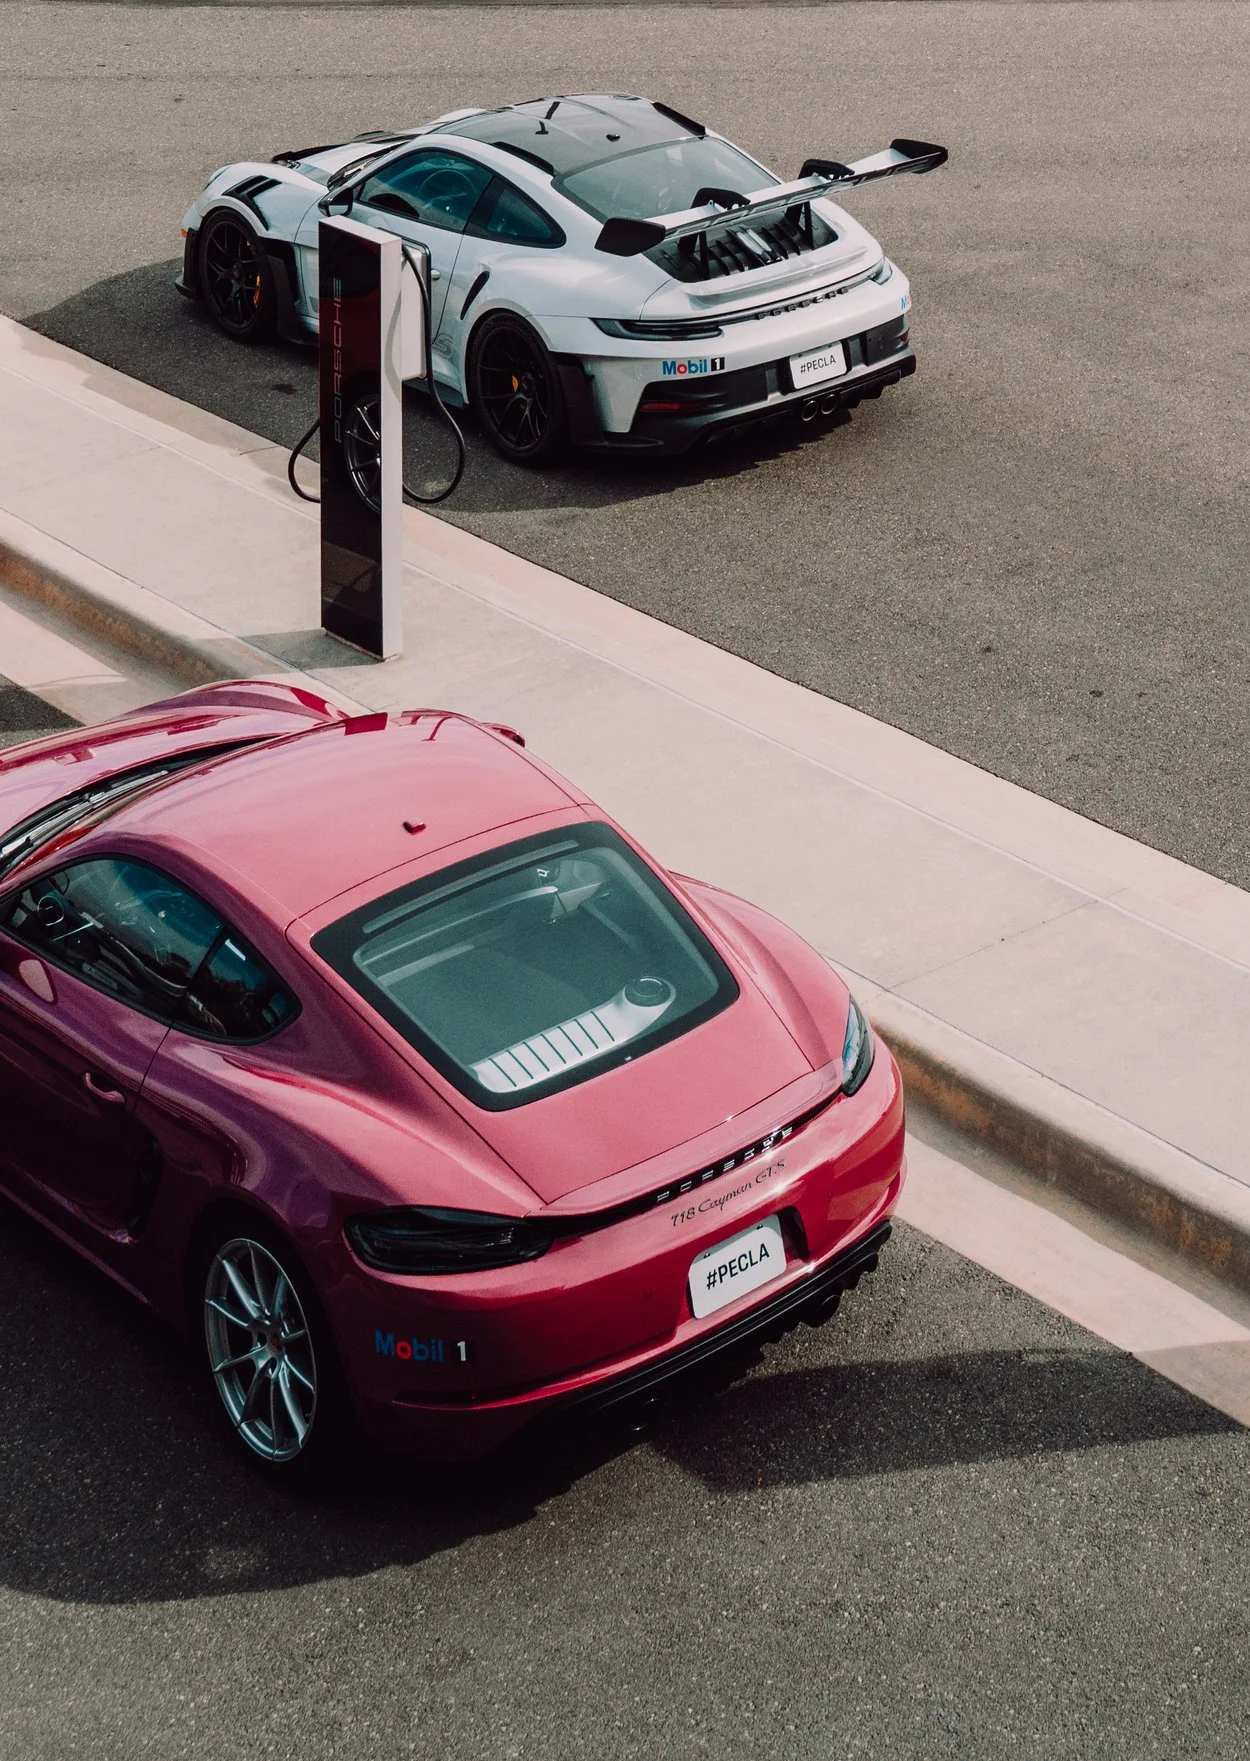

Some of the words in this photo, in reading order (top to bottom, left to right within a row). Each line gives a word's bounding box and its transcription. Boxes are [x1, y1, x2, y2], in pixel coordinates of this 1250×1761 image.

[333, 277, 342, 442] PORSCHE
[662, 358, 708, 375] Mobil
[713, 358, 722, 370] 1
[800, 354, 836, 373] #PECLA
[671, 1206, 695, 1227] 718
[698, 1182, 752, 1212] Cayman
[755, 1159, 785, 1183] GTS
[706, 1242, 770, 1290] #PECLA
[375, 1328, 444, 1362] Mobil
[456, 1339, 468, 1363] 1
